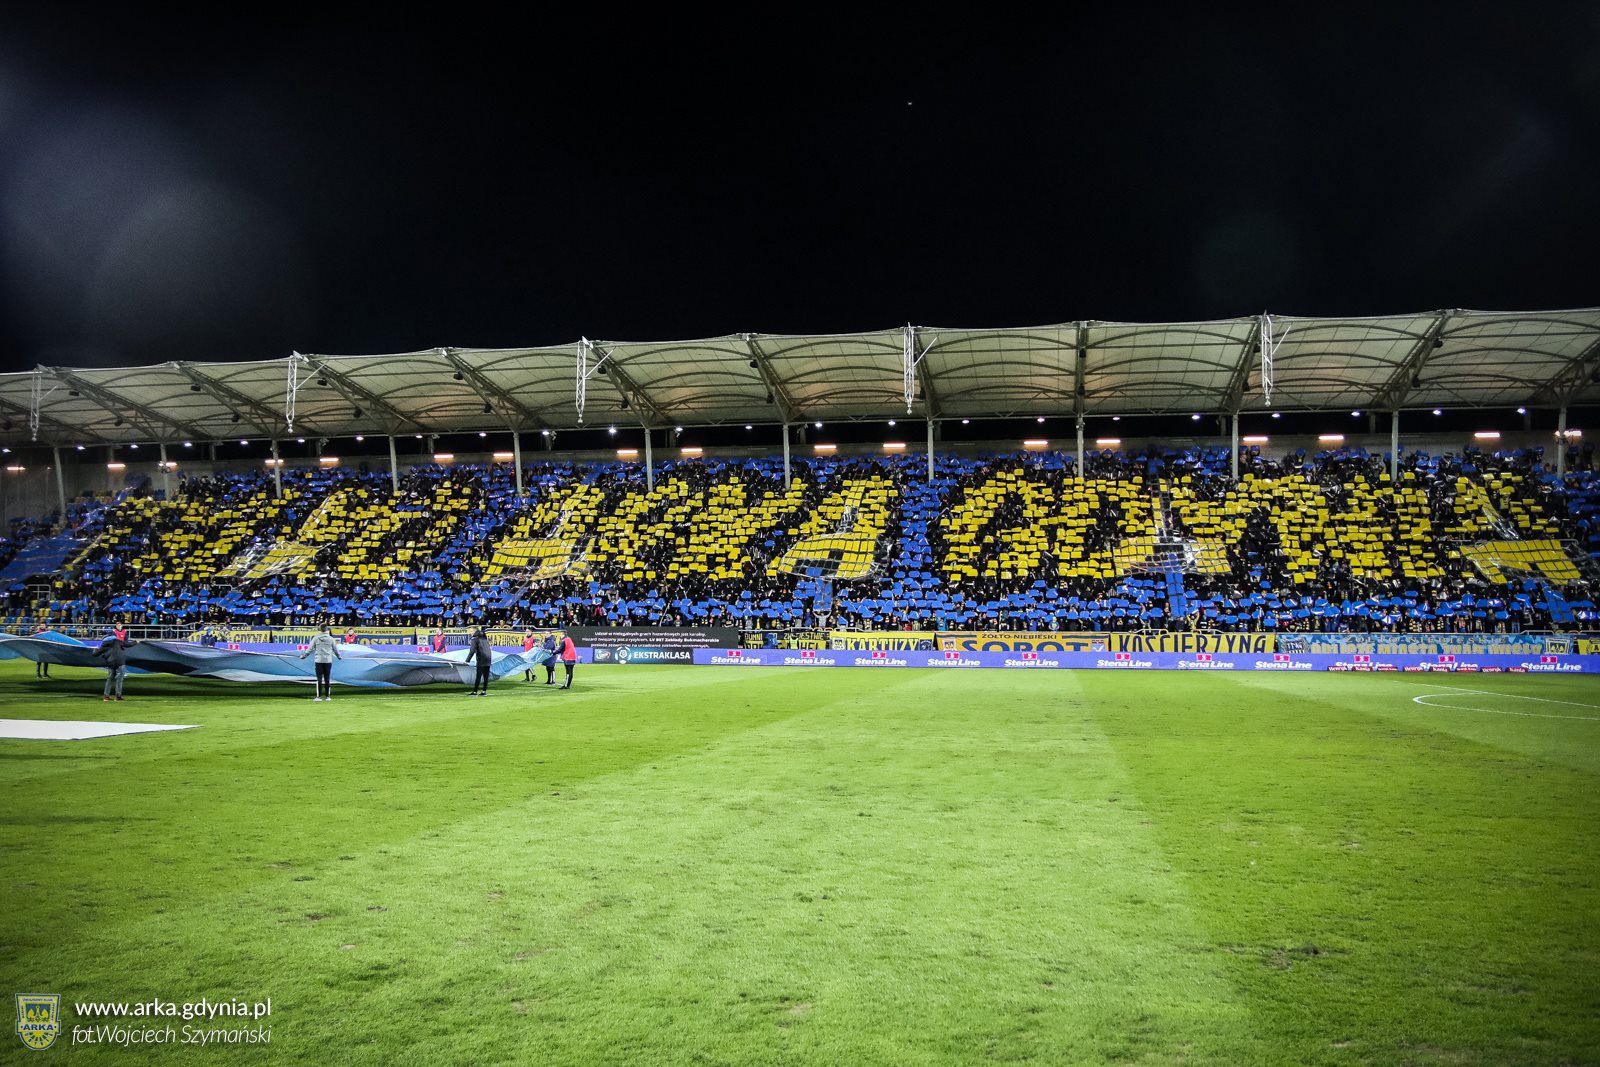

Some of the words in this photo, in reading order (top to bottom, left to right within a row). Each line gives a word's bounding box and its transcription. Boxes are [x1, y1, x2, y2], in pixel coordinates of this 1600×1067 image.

[846, 637, 919, 650] KARTUZY
[633, 651, 691, 660] EKSTRAKLASA
[854, 657, 885, 665] Stena
[885, 657, 907, 665] Line
[927, 658, 958, 666] Stena
[958, 658, 981, 666] Line
[1097, 659, 1129, 667] Stena
[1129, 659, 1152, 667] Line
[1211, 660, 1234, 668] Line
[1255, 661, 1288, 669] Stena
[1288, 661, 1312, 669] Line
[1521, 662, 1556, 671] Stena
[1556, 662, 1582, 671] Line
